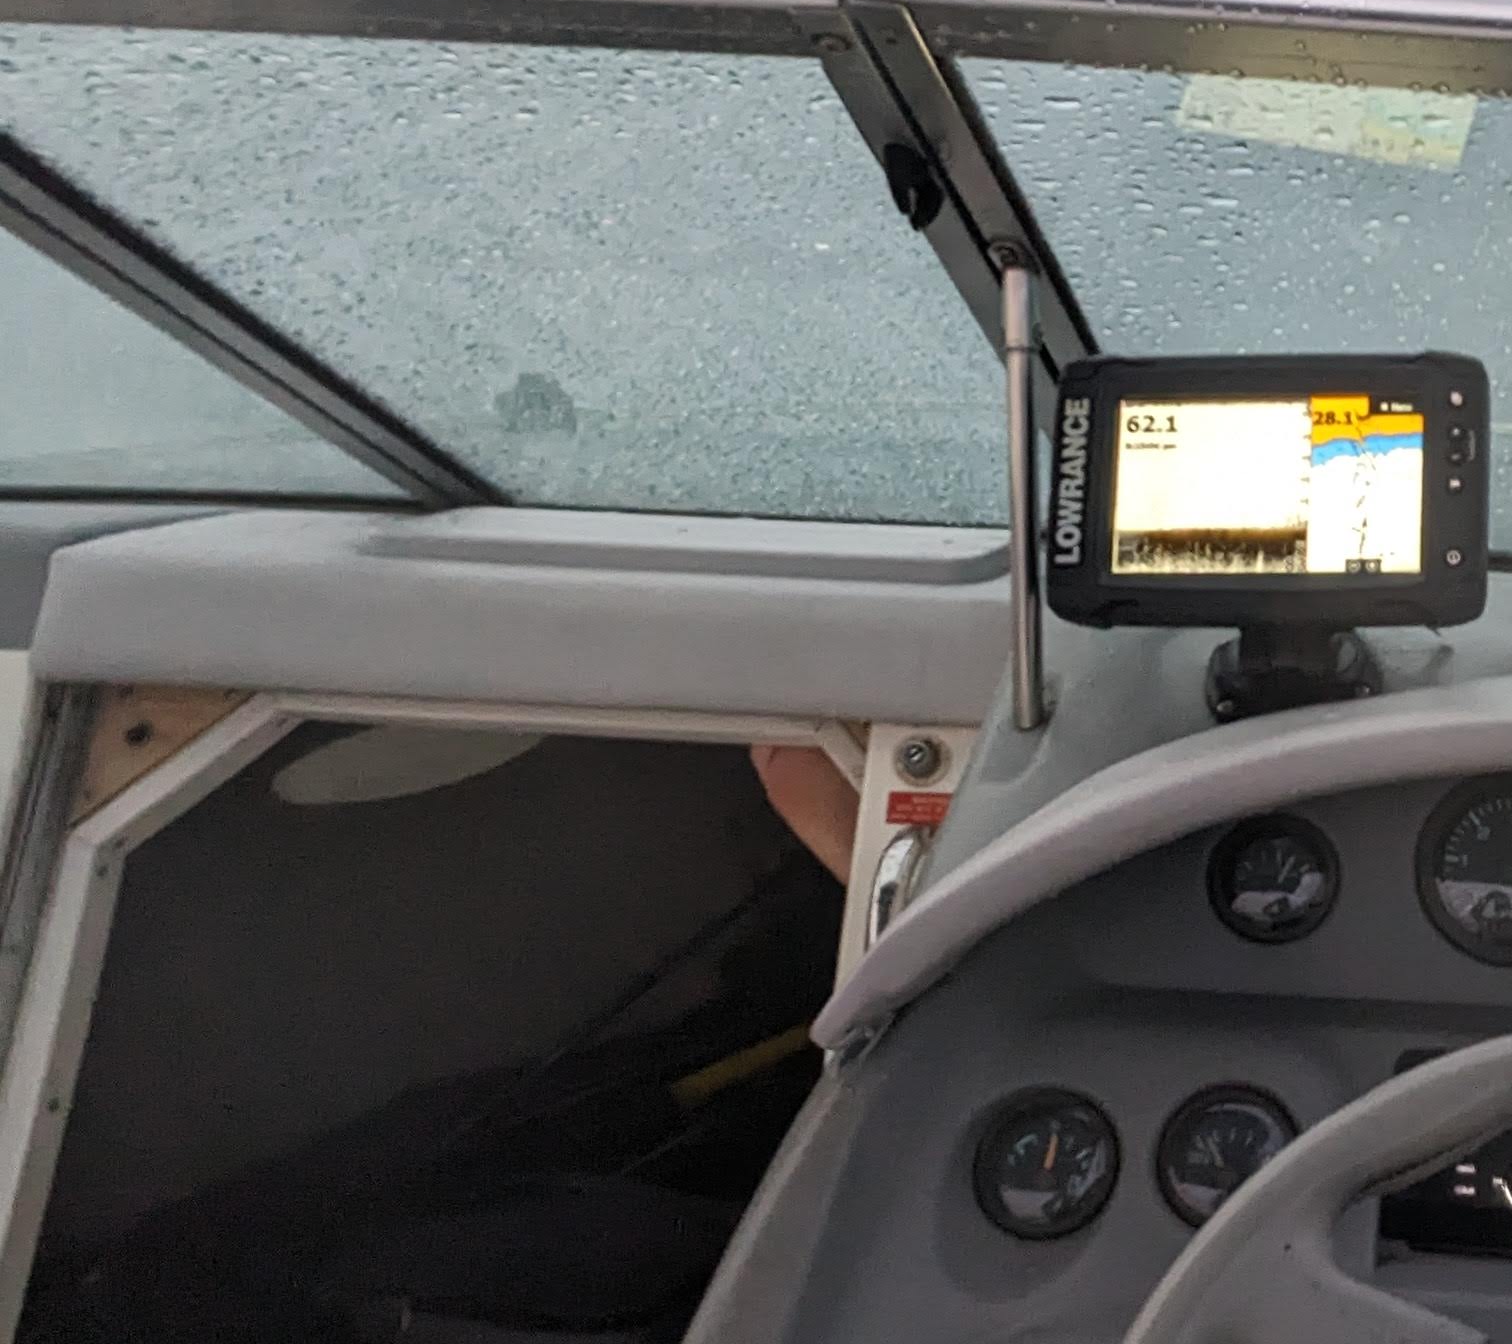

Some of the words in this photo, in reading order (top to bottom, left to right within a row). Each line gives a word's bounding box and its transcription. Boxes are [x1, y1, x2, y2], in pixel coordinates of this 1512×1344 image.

[1126, 415, 1178, 433] 62.1
[1312, 411, 1353, 425] 28.1
[1055, 397, 1091, 565] LOWRANCE
